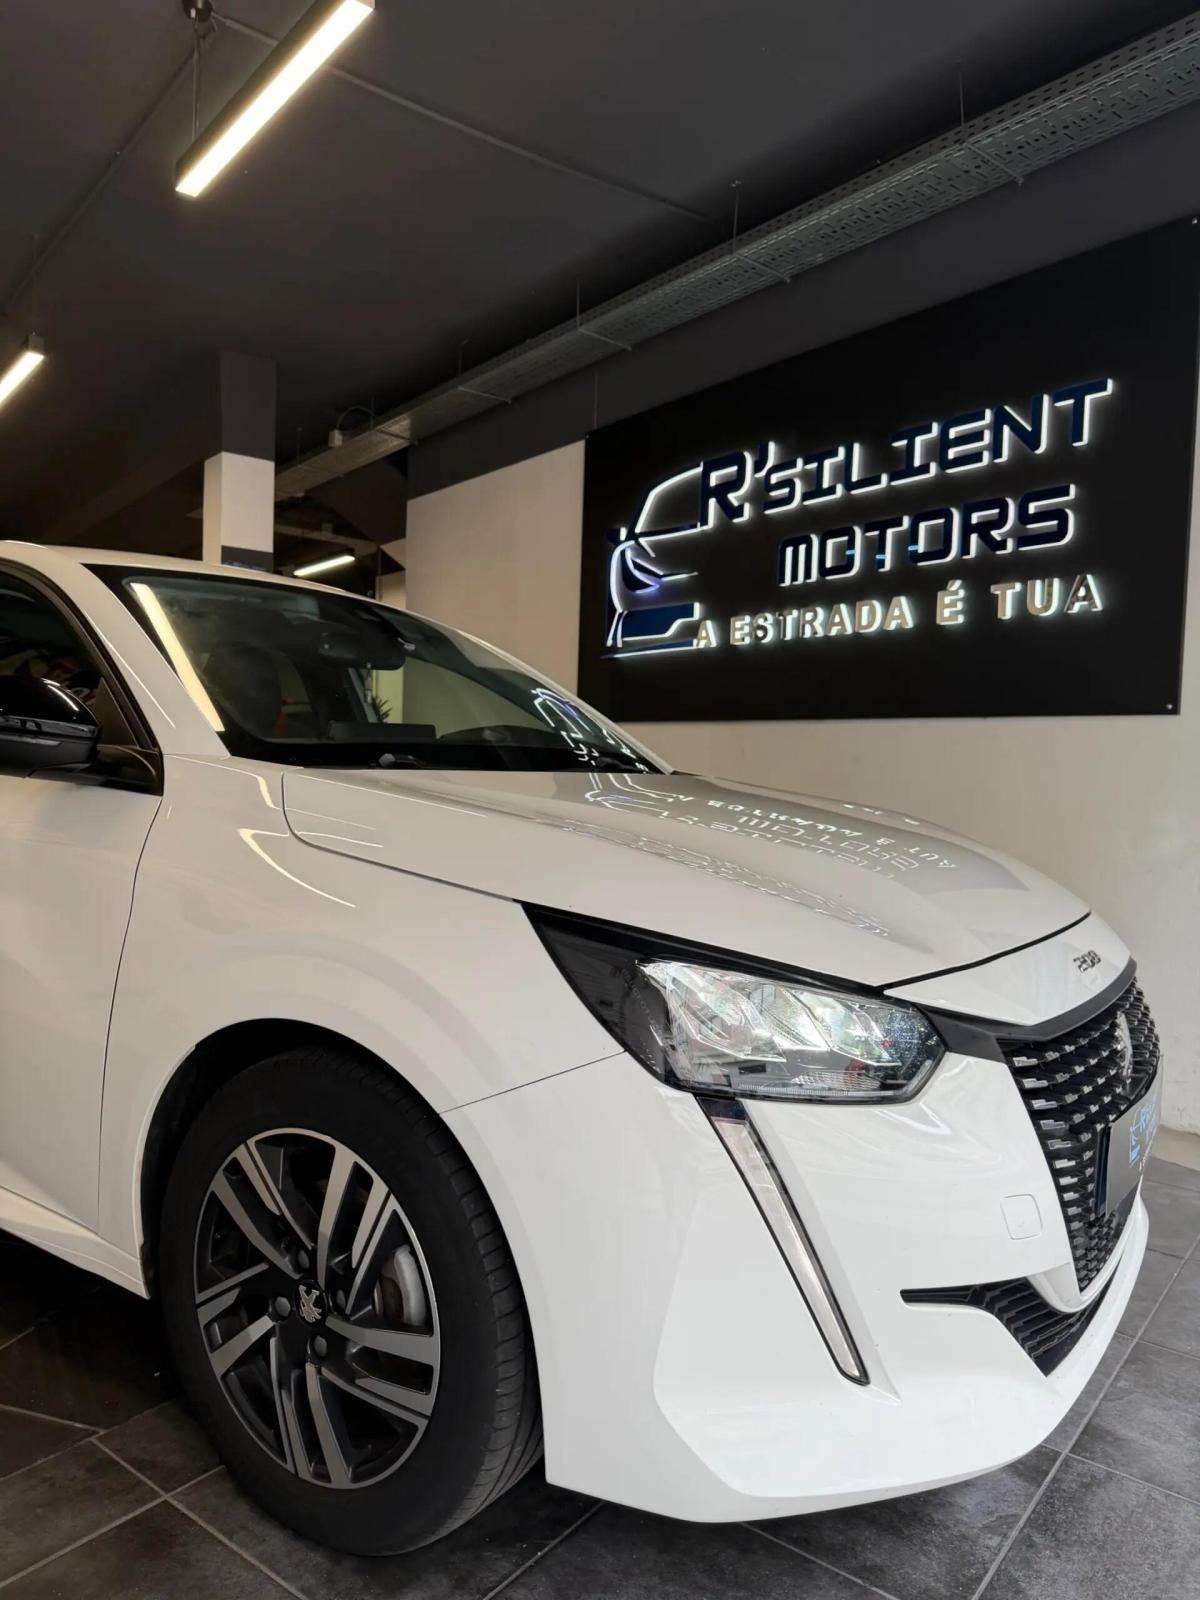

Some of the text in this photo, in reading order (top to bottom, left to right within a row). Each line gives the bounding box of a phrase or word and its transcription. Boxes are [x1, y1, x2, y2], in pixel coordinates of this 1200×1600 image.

[778, 484, 1076, 586] MOTORS
[694, 573, 1104, 649] A ESTRADA É TUA
